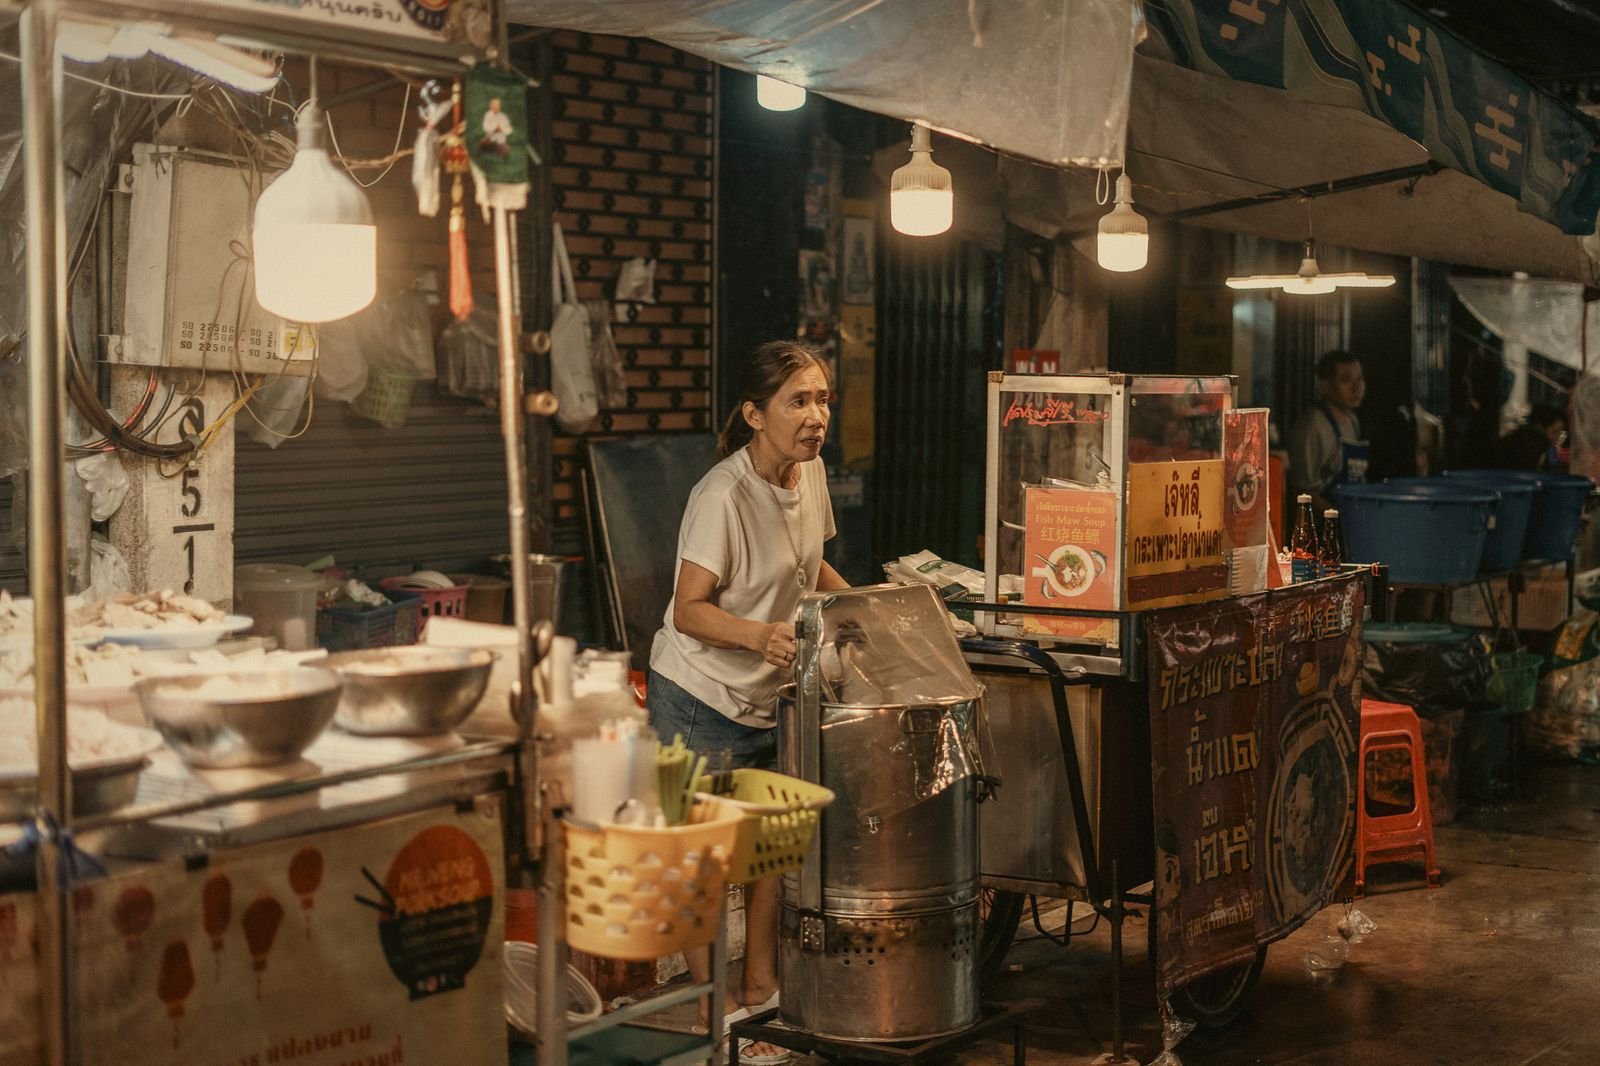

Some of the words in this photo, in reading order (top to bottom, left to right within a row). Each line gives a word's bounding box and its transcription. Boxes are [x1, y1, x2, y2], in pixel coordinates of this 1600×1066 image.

[199, 331, 234, 342] 2506
[1036, 514, 1053, 525] Fish
[1056, 515, 1080, 526] Maw
[1083, 517, 1106, 529] Soup
